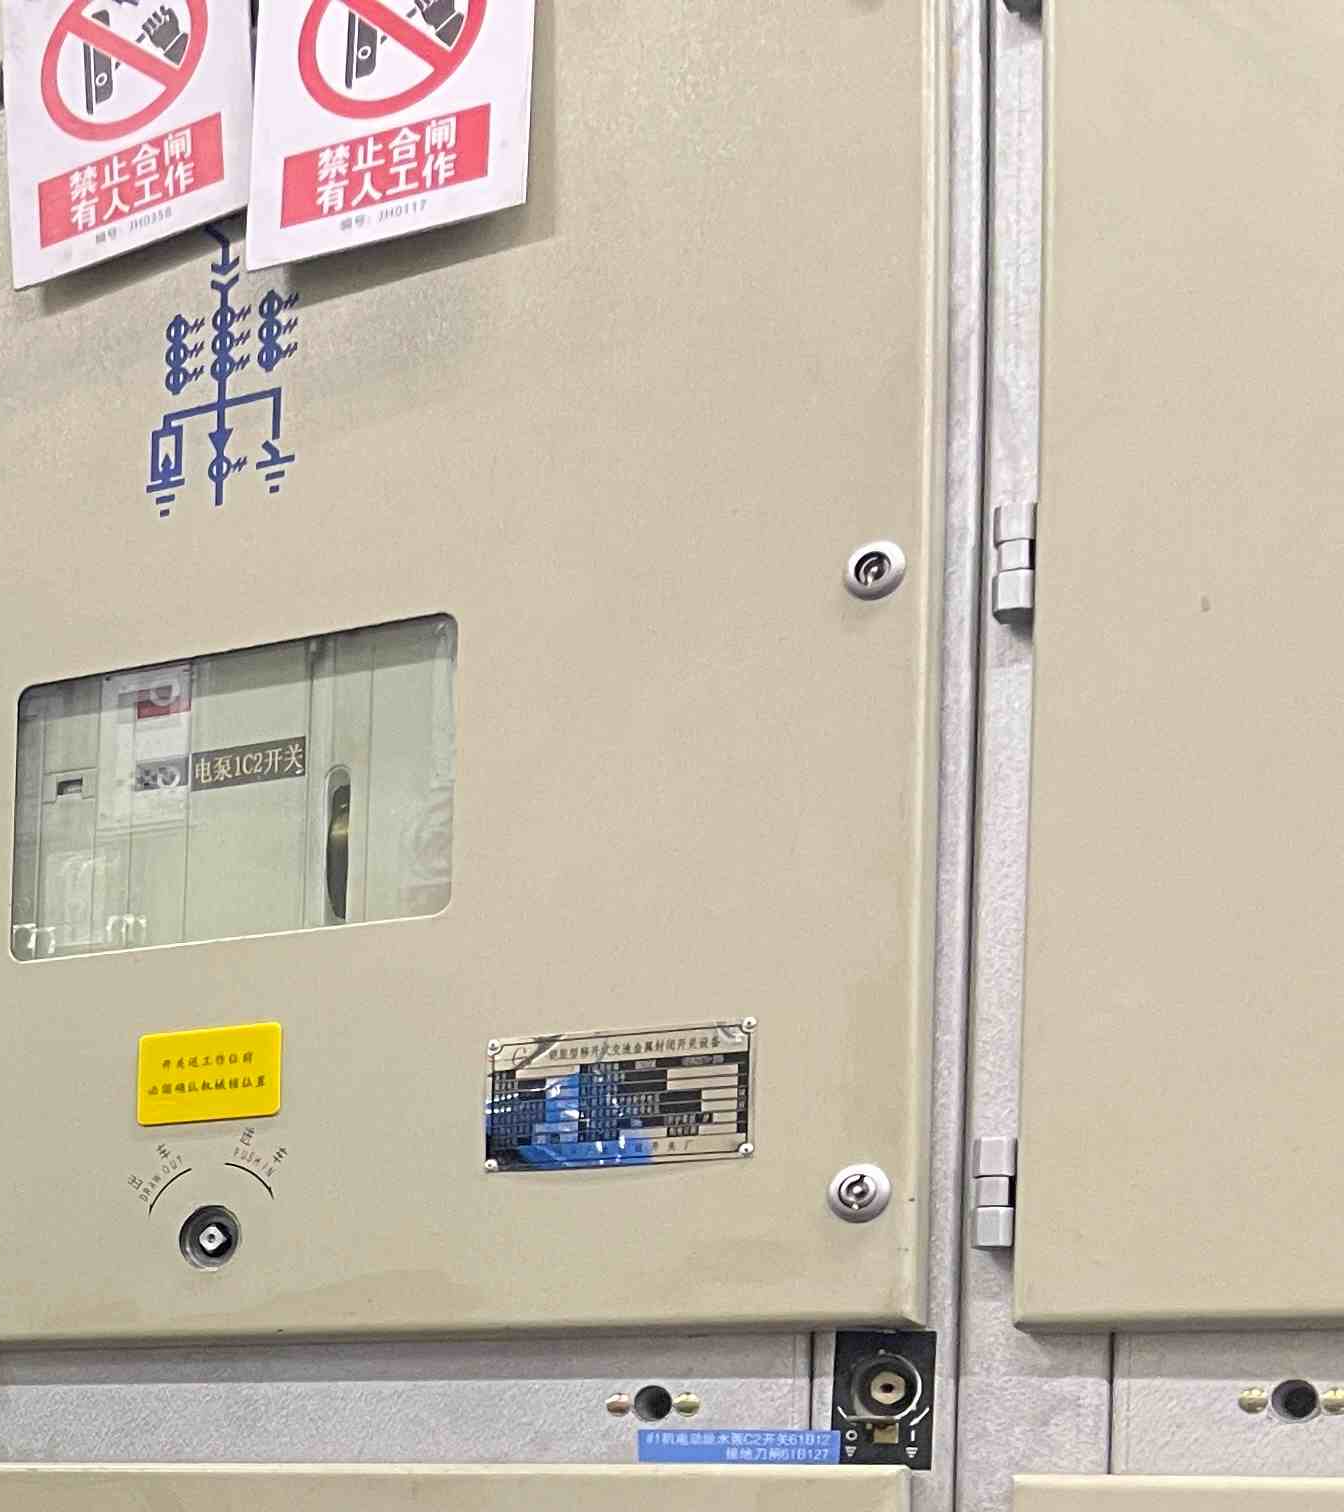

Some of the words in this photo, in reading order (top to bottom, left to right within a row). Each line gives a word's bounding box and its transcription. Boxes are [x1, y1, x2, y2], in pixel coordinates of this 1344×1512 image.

[69, 129, 193, 201] 禁止合闸
[317, 115, 457, 182] 禁止合闸
[70, 161, 195, 231] 有人工作
[316, 152, 457, 214] 有人工作
[195, 743, 304, 784] 电泵1C2开关
